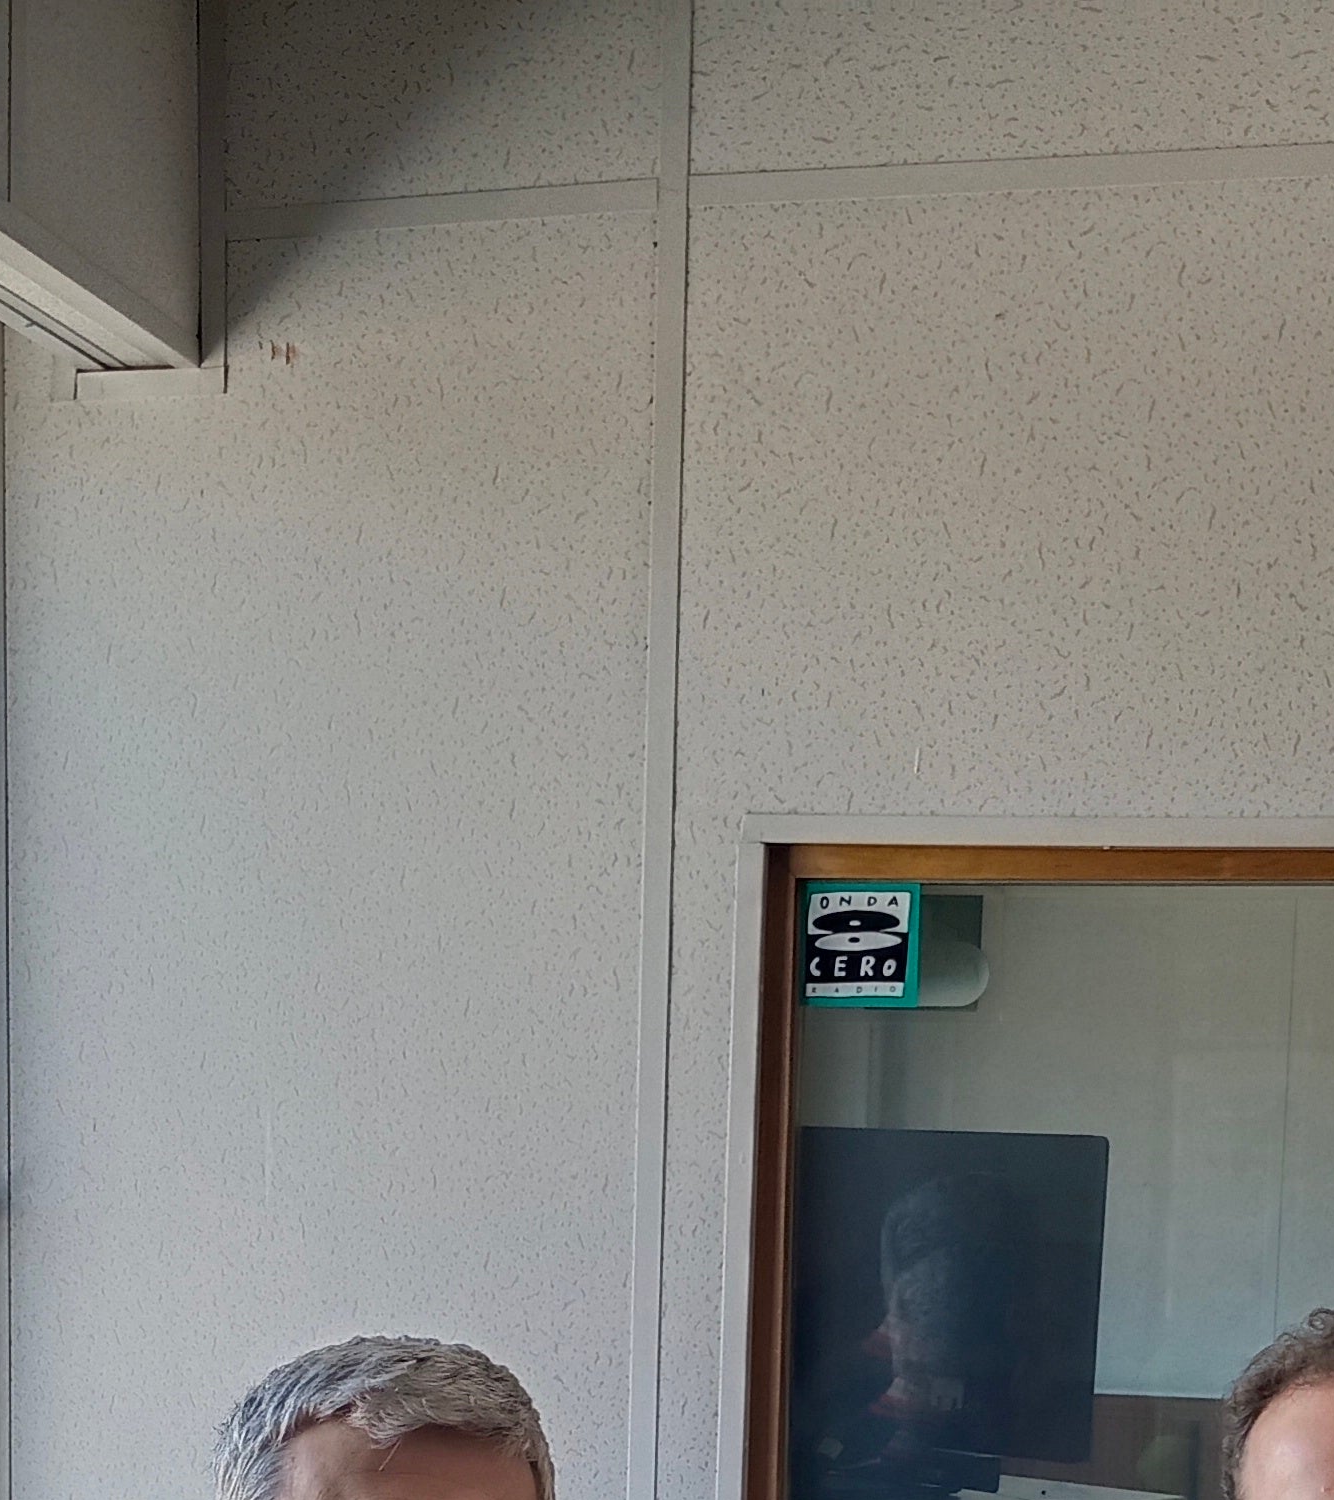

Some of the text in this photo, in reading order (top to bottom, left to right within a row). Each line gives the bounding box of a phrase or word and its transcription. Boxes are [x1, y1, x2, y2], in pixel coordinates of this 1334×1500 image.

[819, 895, 899, 909] ONDA
[809, 955, 897, 977] CERO
[811, 986, 897, 994] RADIO
